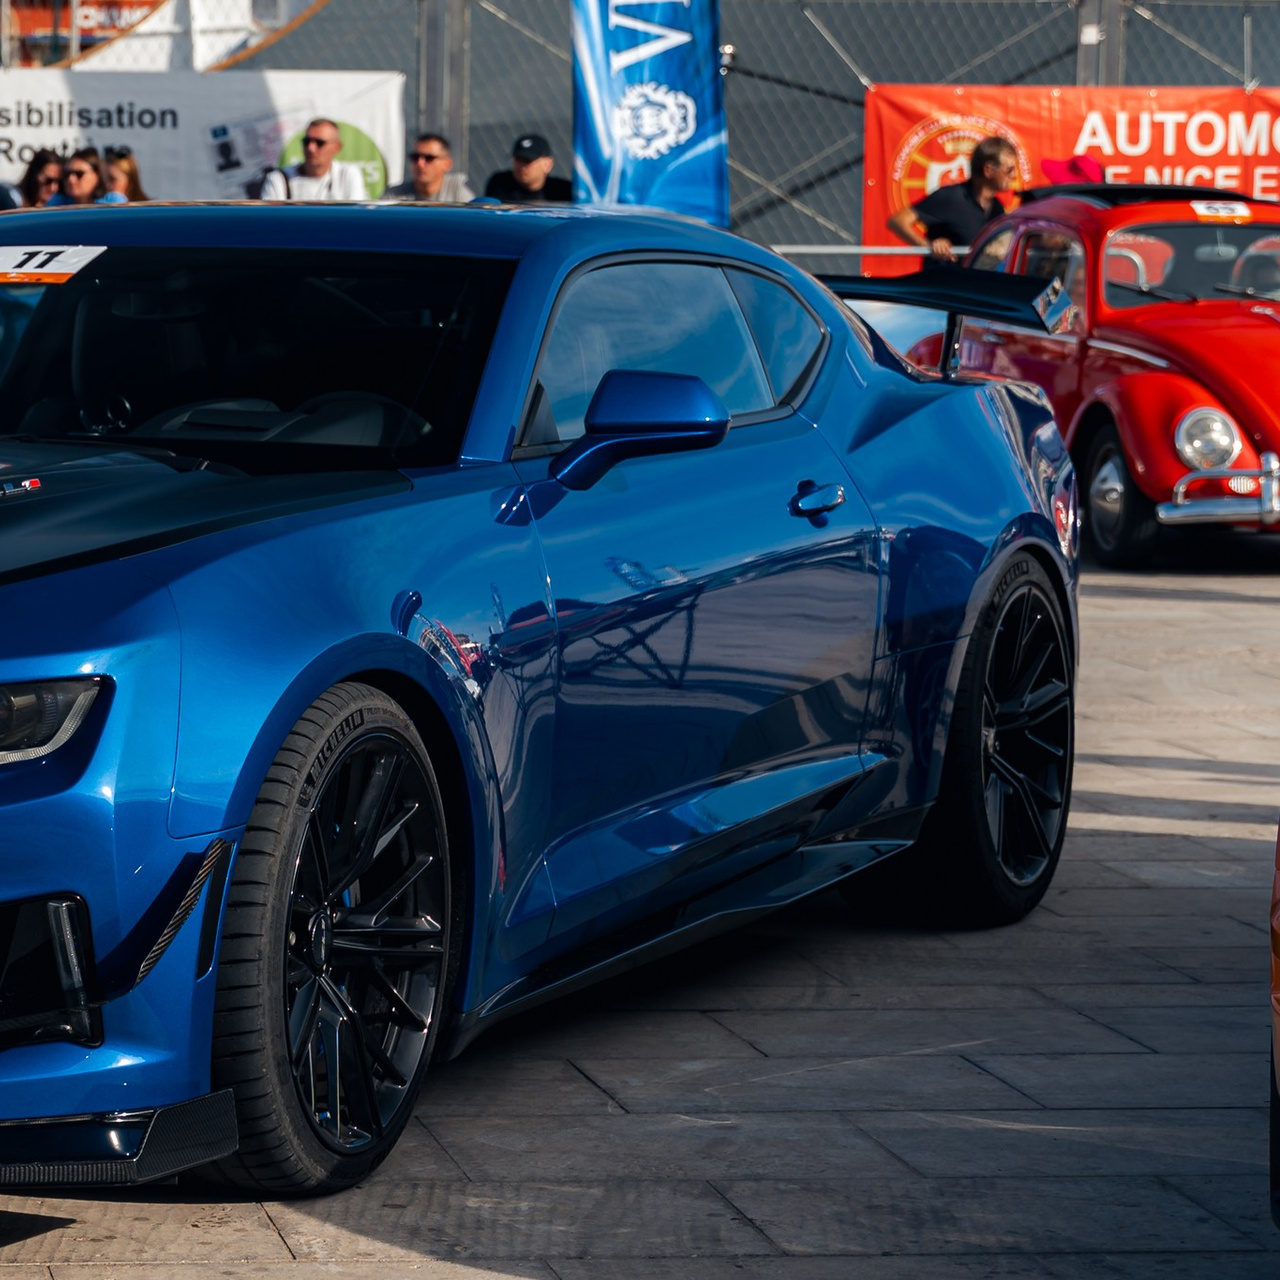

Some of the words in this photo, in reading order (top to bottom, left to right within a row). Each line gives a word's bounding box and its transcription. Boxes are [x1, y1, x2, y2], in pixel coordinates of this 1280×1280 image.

[1073, 110, 1280, 157] AUTOM
[13, 250, 65, 269] 11
[310, 708, 364, 784] MICHELIN
